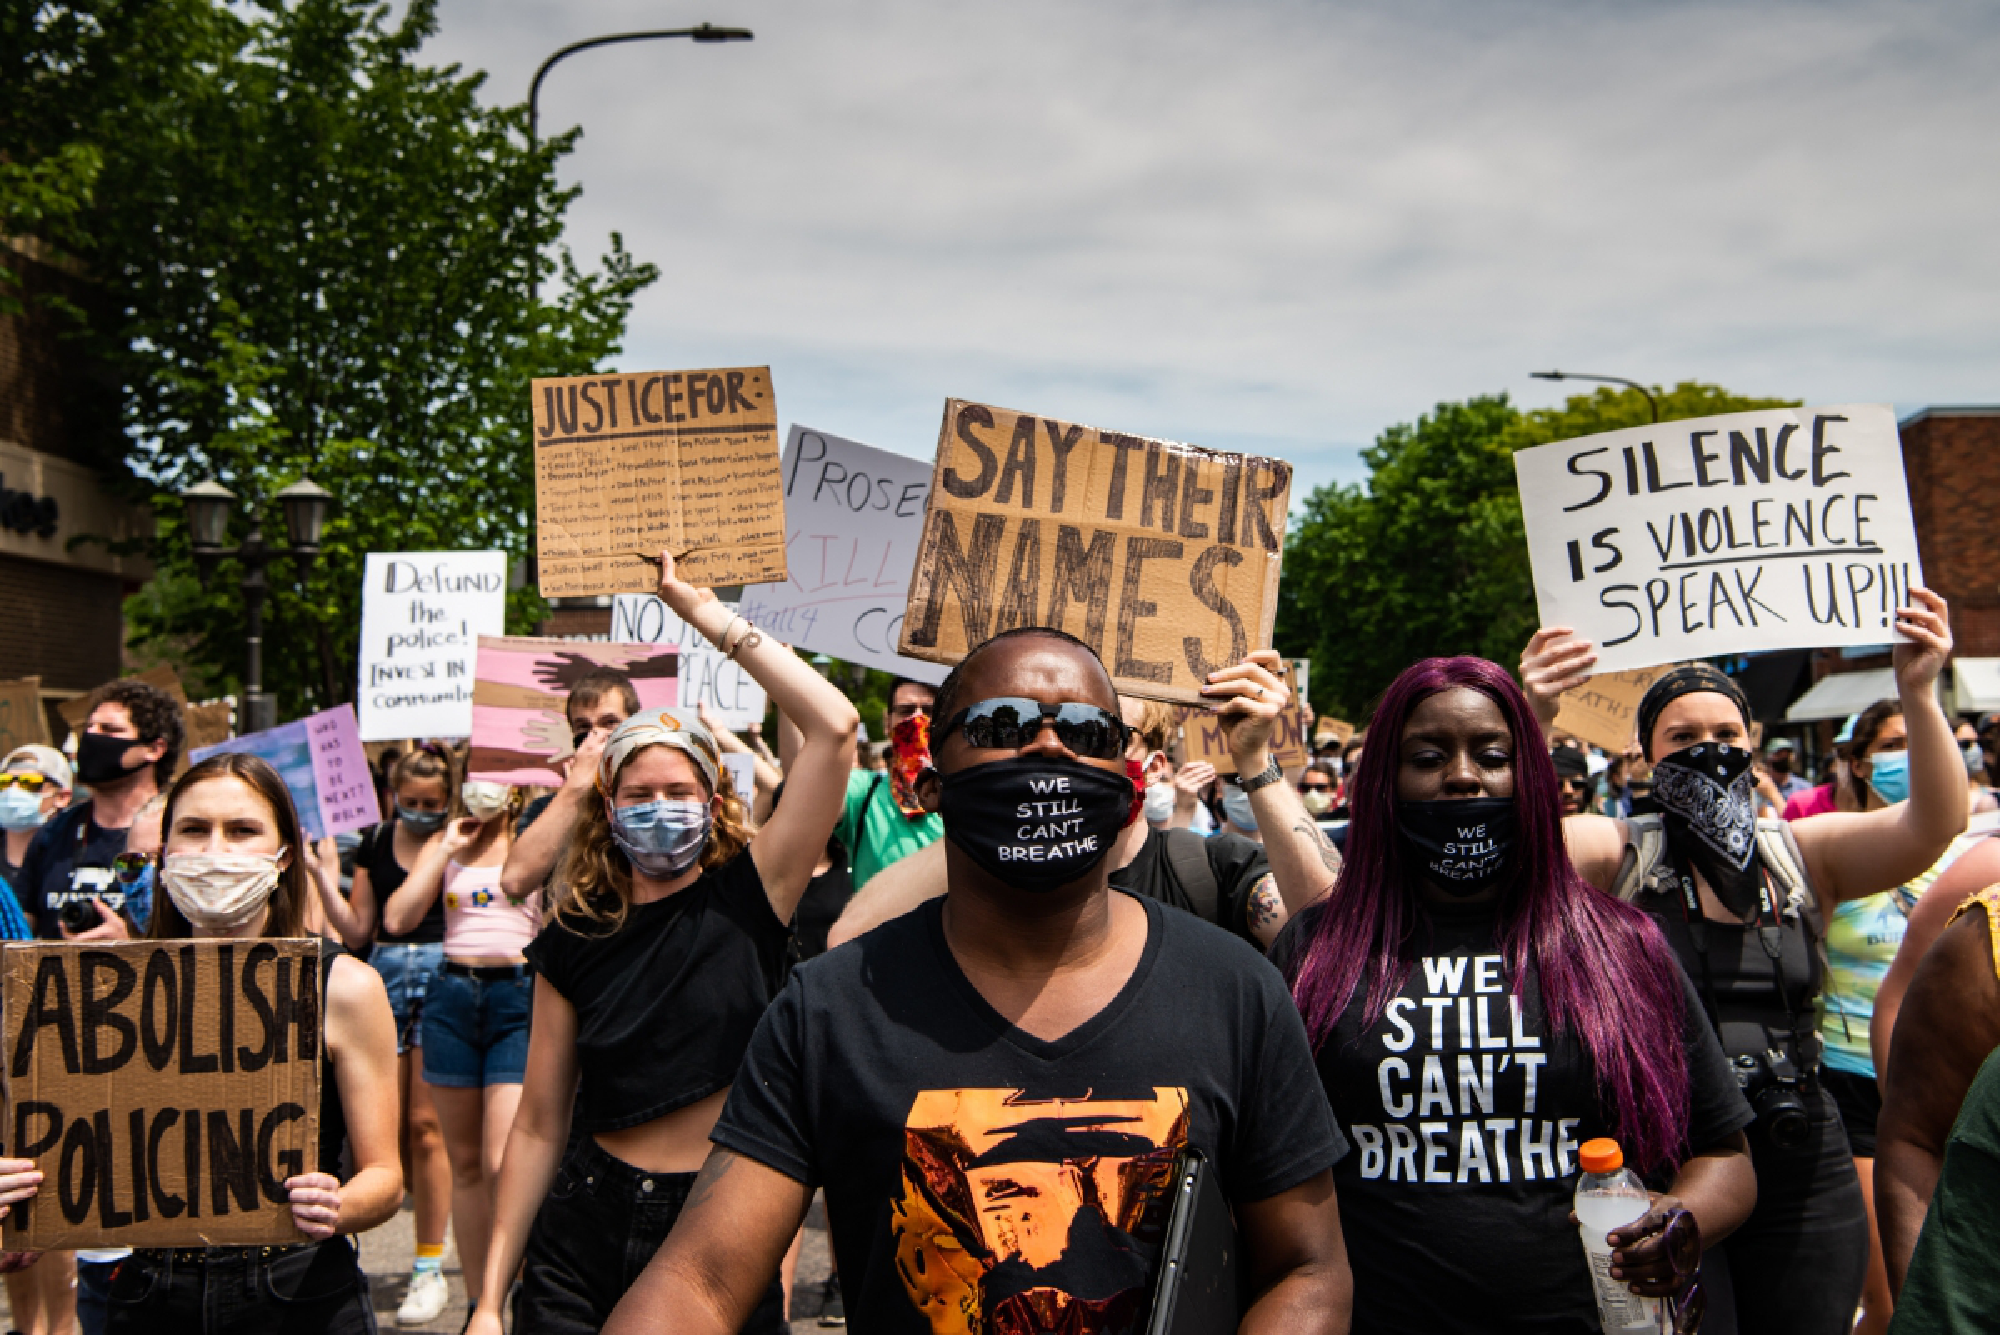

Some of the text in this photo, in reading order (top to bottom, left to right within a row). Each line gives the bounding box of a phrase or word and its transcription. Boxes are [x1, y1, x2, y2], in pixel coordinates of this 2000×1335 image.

[537, 372, 686, 438] JUSTICE
[786, 431, 930, 518] PROSE
[943, 404, 1290, 553] SAY THEIR
[1563, 414, 1851, 513] SILENCE
[1567, 494, 1879, 582] IS VIOLENCE
[614, 596, 664, 643] NO
[909, 510, 1249, 690] NAMES
[1600, 564, 1788, 648] SPEAK
[1016, 798, 1083, 818] STILL
[1029, 777, 1071, 795] WE
[997, 834, 1098, 862] BREATHE
[1016, 818, 1084, 840] CAN'T
[1443, 838, 1498, 856] STILL
[1456, 823, 1486, 839] WE
[1421, 955, 1503, 995] WE
[11, 942, 319, 1078] ABOLISH
[1381, 994, 1541, 1052] STILL
[1377, 1052, 1548, 1118] CAN'T
[13, 1101, 306, 1231] POLICING
[1352, 1117, 1581, 1184] BREATHE
